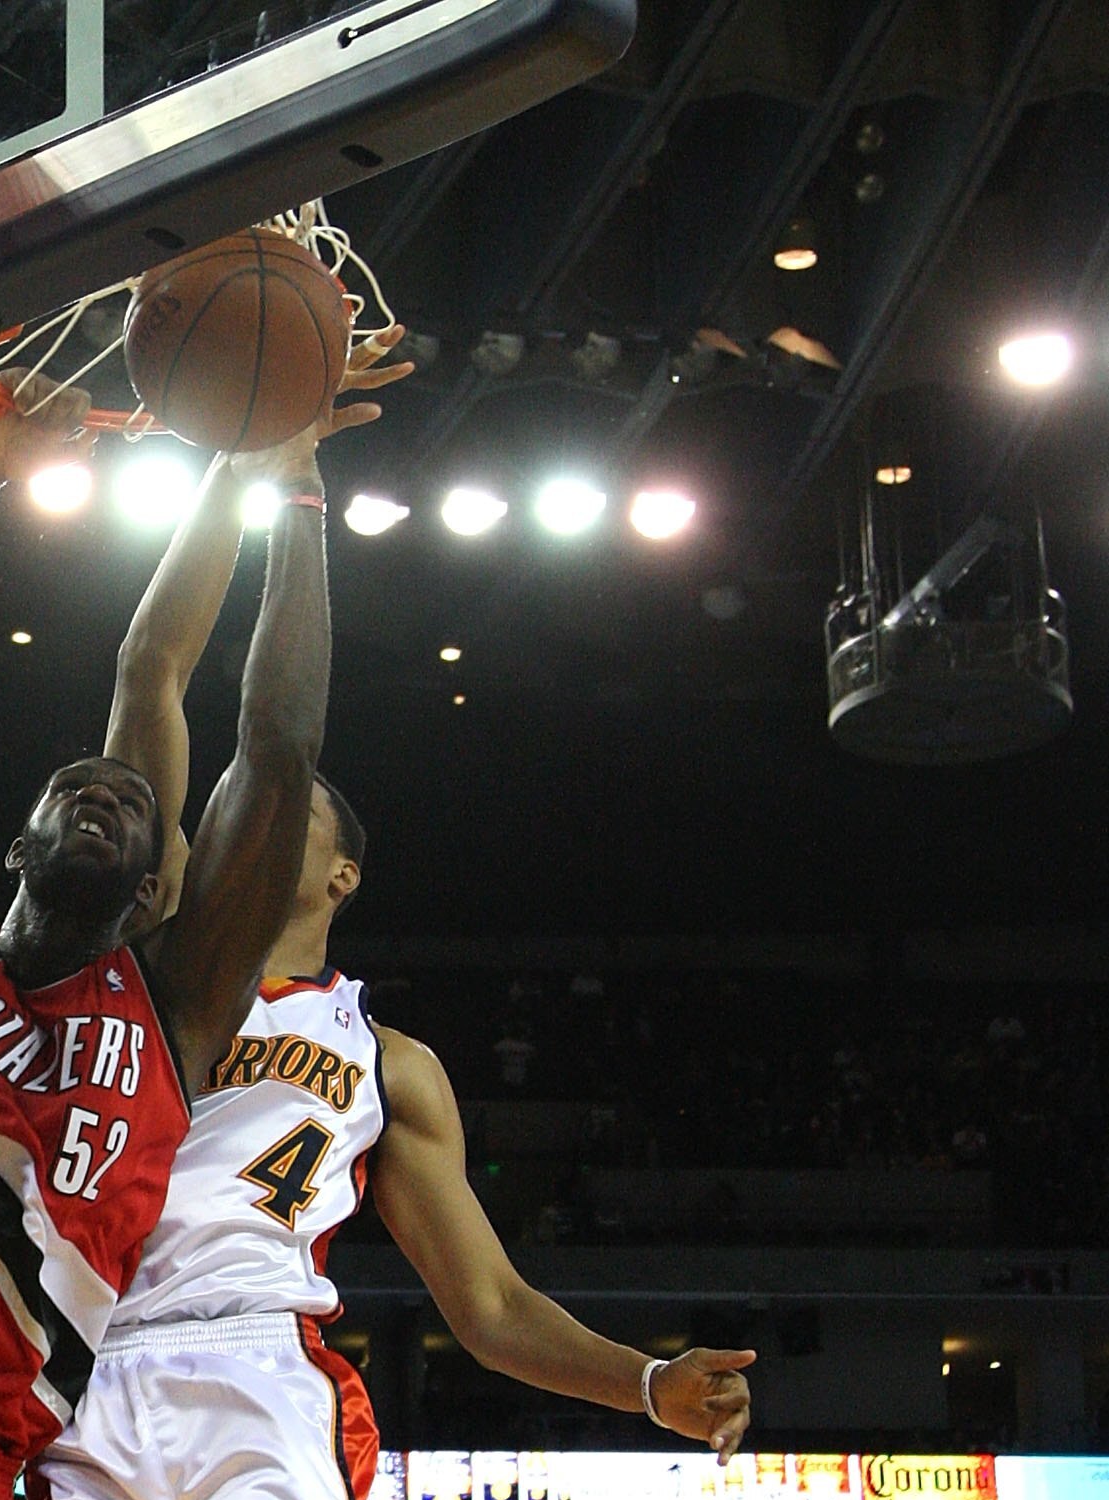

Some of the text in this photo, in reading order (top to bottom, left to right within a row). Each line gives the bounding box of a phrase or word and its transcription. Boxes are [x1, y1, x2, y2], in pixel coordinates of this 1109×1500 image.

[52, 1106, 129, 1201] 52
[236, 1117, 335, 1232] 4
[866, 1454, 989, 1498] Corona
